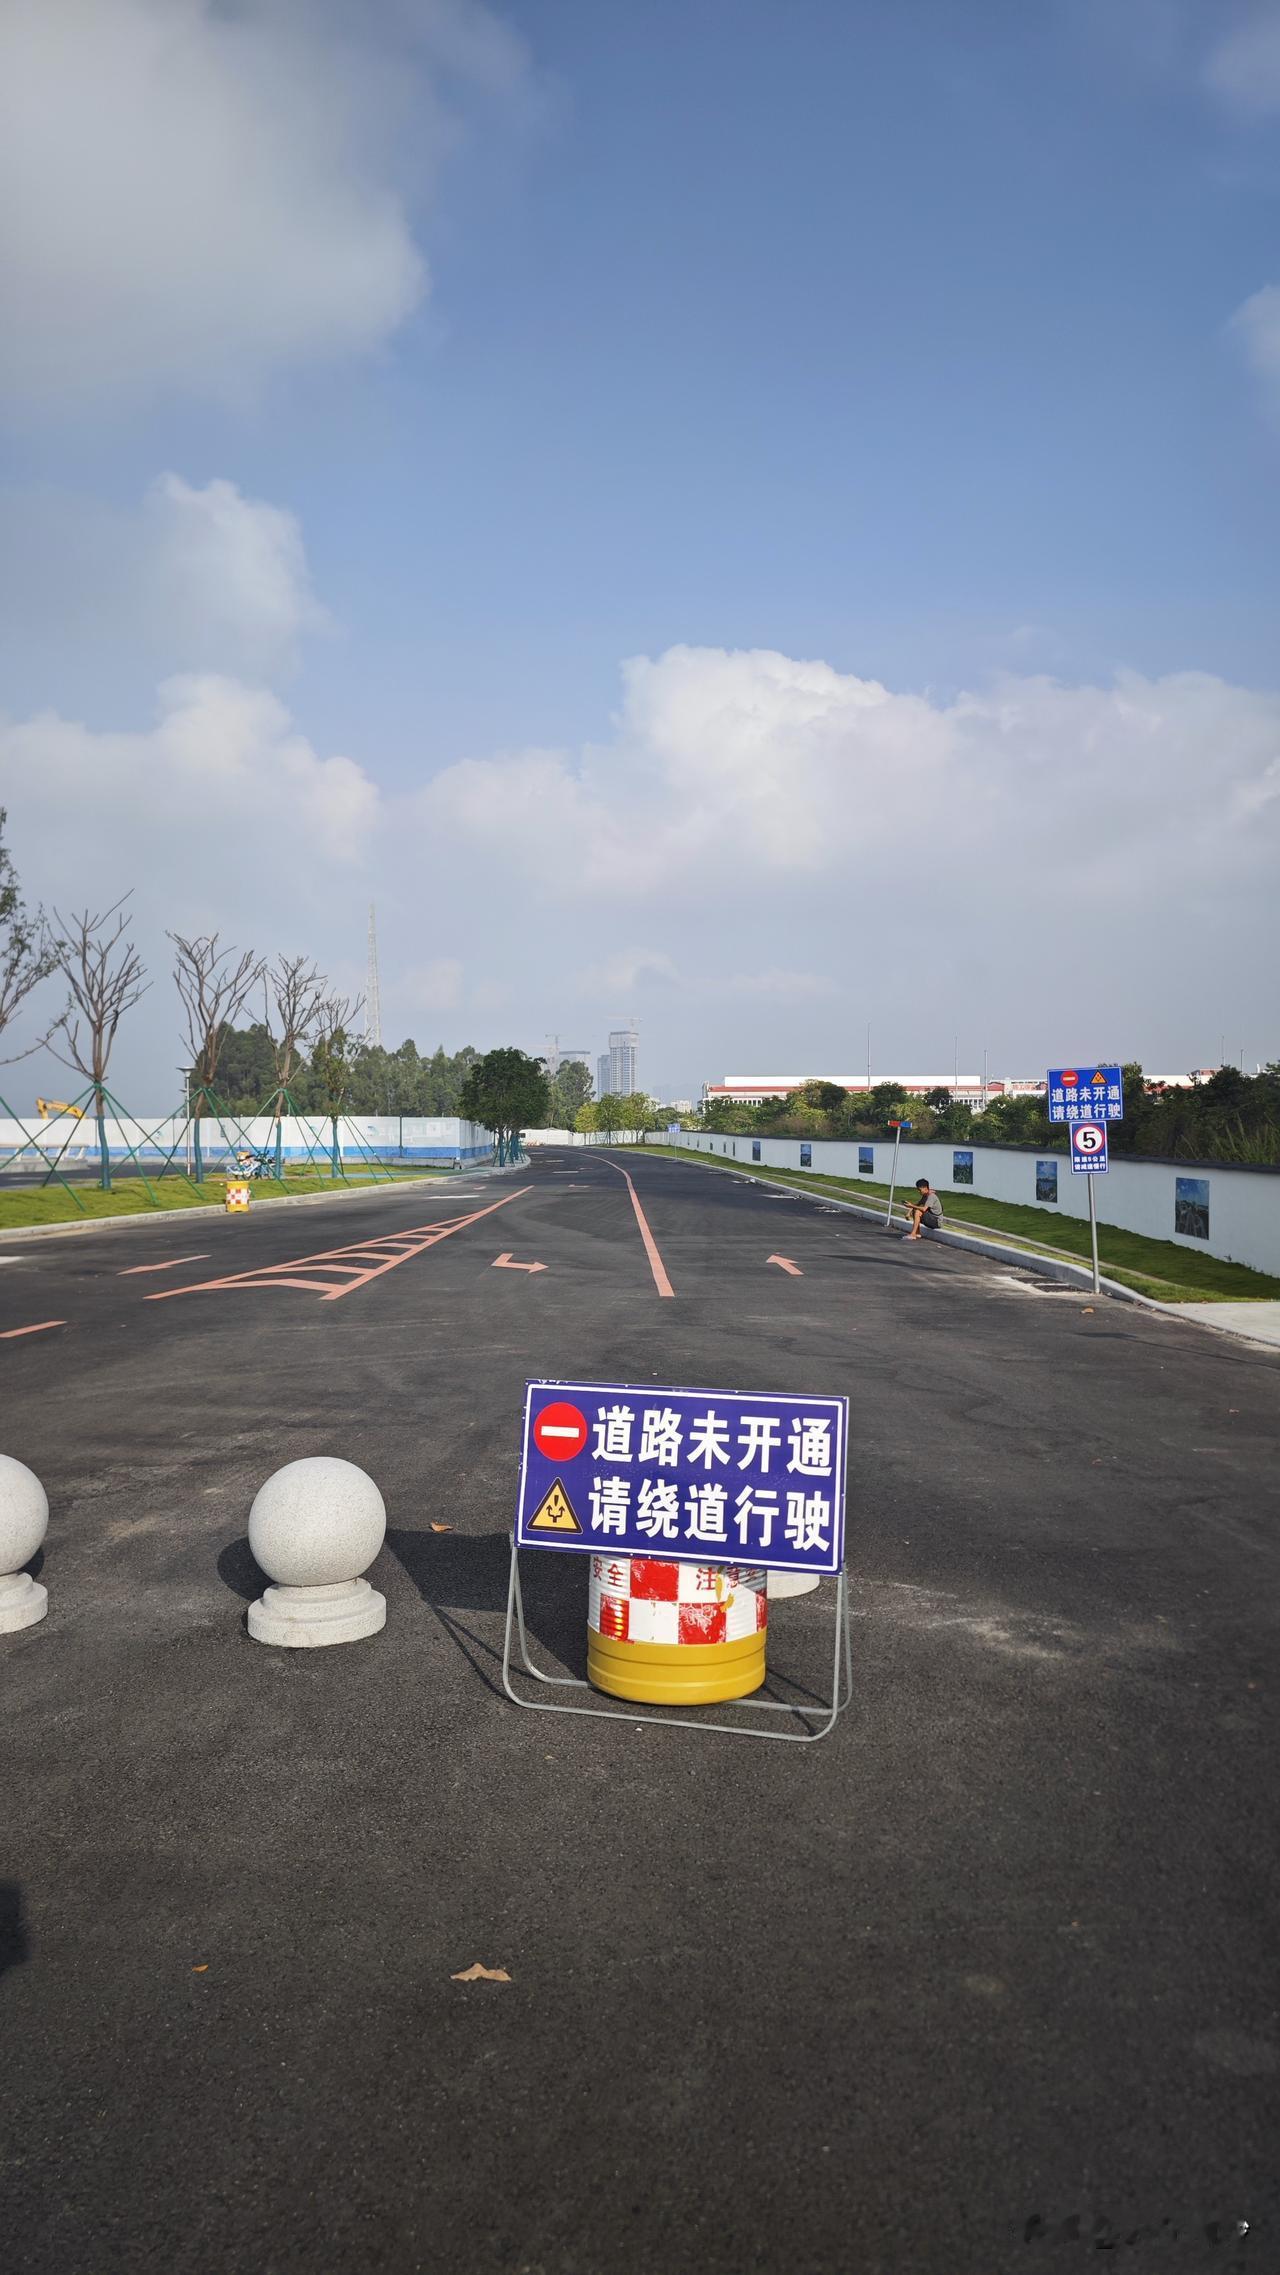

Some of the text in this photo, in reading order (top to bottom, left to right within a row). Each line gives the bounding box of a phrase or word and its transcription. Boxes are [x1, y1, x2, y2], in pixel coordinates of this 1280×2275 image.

[1051, 1085, 1120, 1103] 道路未开通
[1052, 1103, 1121, 1120] 请绕道行驶
[1083, 1131, 1096, 1149] 5
[591, 1405, 833, 1477] 道路未开通
[588, 1475, 831, 1552] 请绕道行驶
[593, 1555, 624, 1588] 安全
